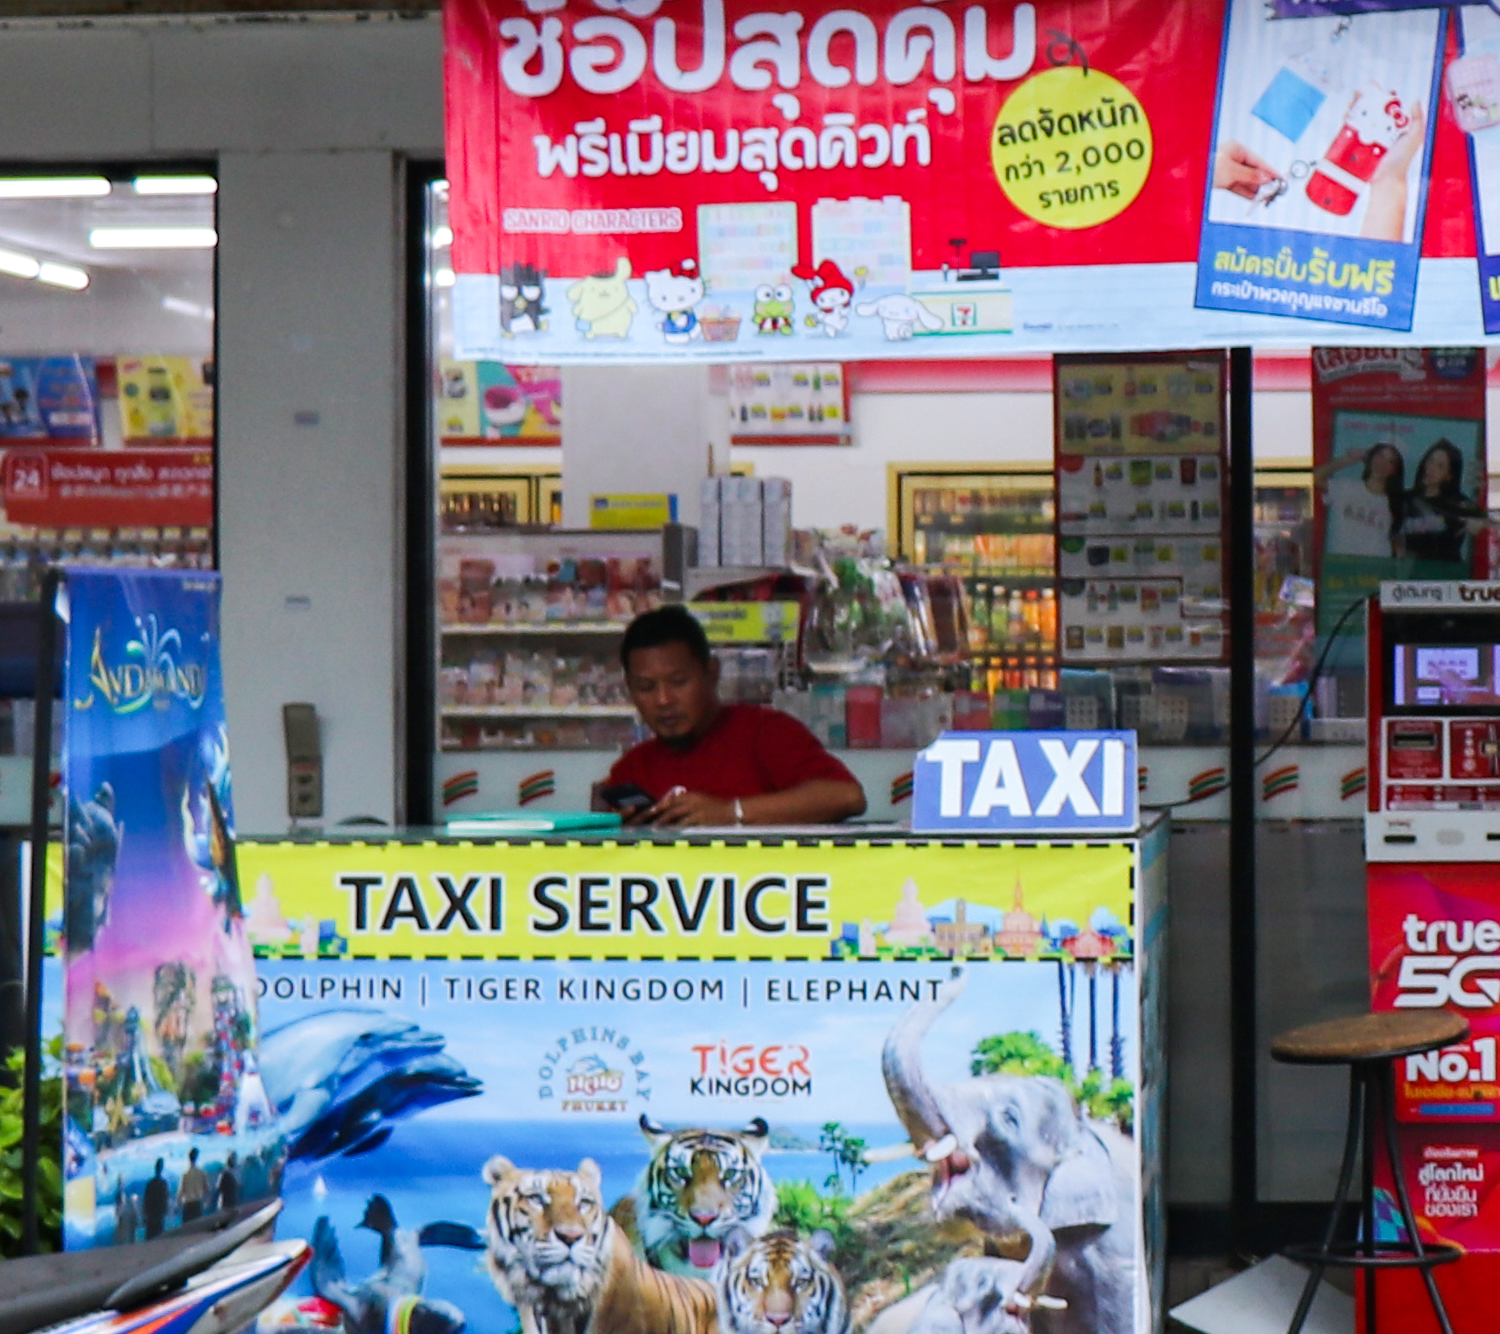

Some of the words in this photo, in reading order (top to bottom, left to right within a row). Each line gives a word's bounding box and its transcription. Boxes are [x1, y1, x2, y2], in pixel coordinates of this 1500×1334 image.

[996, 101, 1141, 147] ลดจัดหนัก
[534, 108, 932, 191] พรีเมียมสุดคิวท์
[1004, 156, 1047, 185] กว่า
[1056, 139, 1147, 177] 2,000
[1038, 178, 1121, 211] รายการ
[504, 210, 569, 232] SANRIO
[572, 208, 682, 233] CHARACTERS
[925, 737, 1127, 817] TAXI
[340, 874, 504, 933] TAXI
[531, 874, 831, 934] SERVICE
[444, 976, 543, 1003] TIGER
[557, 976, 726, 1003] KINGDOM
[765, 977, 944, 1004] ELEPHANT
[539, 1025, 632, 1100] DOLPHINS
[629, 1051, 652, 1102] BAY
[1405, 1036, 1497, 1082] No.1
[690, 1077, 813, 1097] KINGDOM
